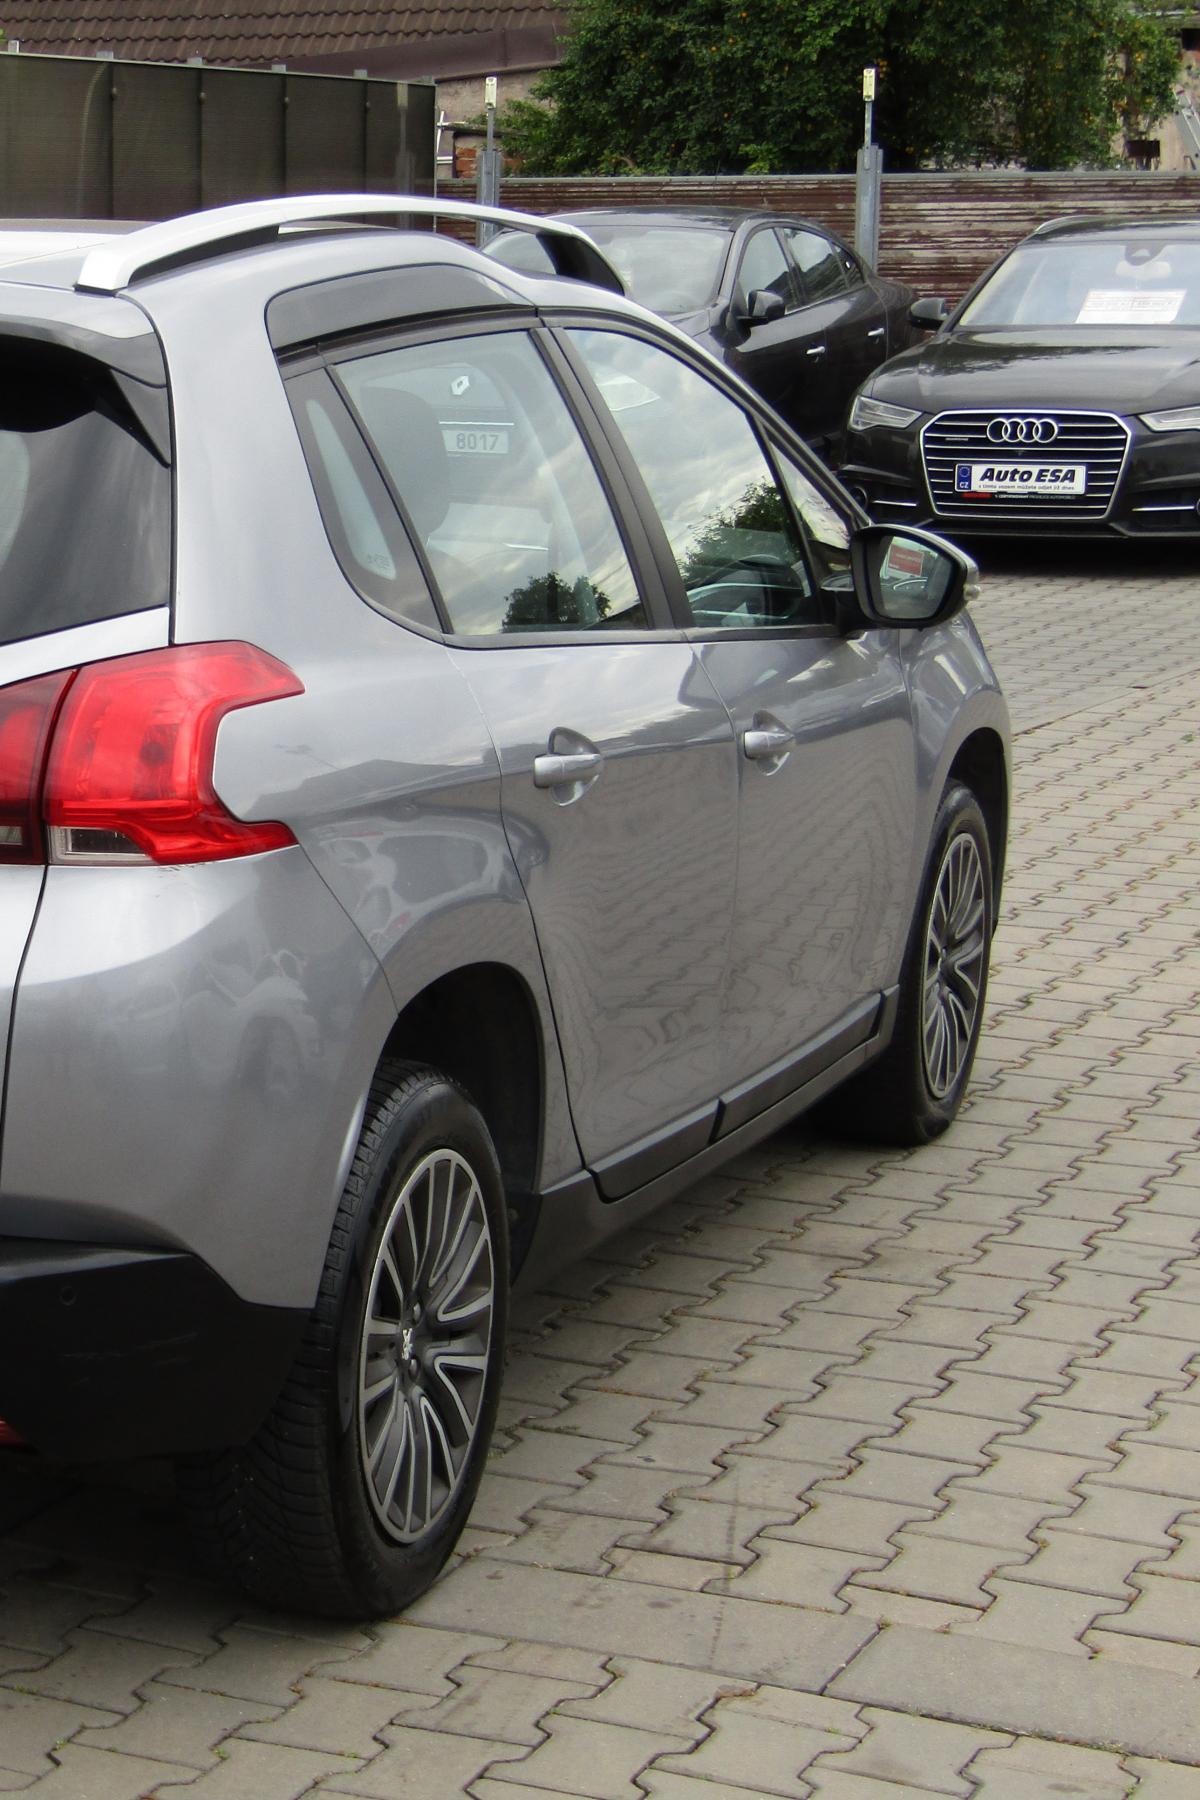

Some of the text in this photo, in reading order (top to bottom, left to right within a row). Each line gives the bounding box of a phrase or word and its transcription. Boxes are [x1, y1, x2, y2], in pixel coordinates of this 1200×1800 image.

[456, 432, 499, 451] 8017
[980, 468, 1076, 483] Auto ESA
[959, 481, 969, 489] CZ
